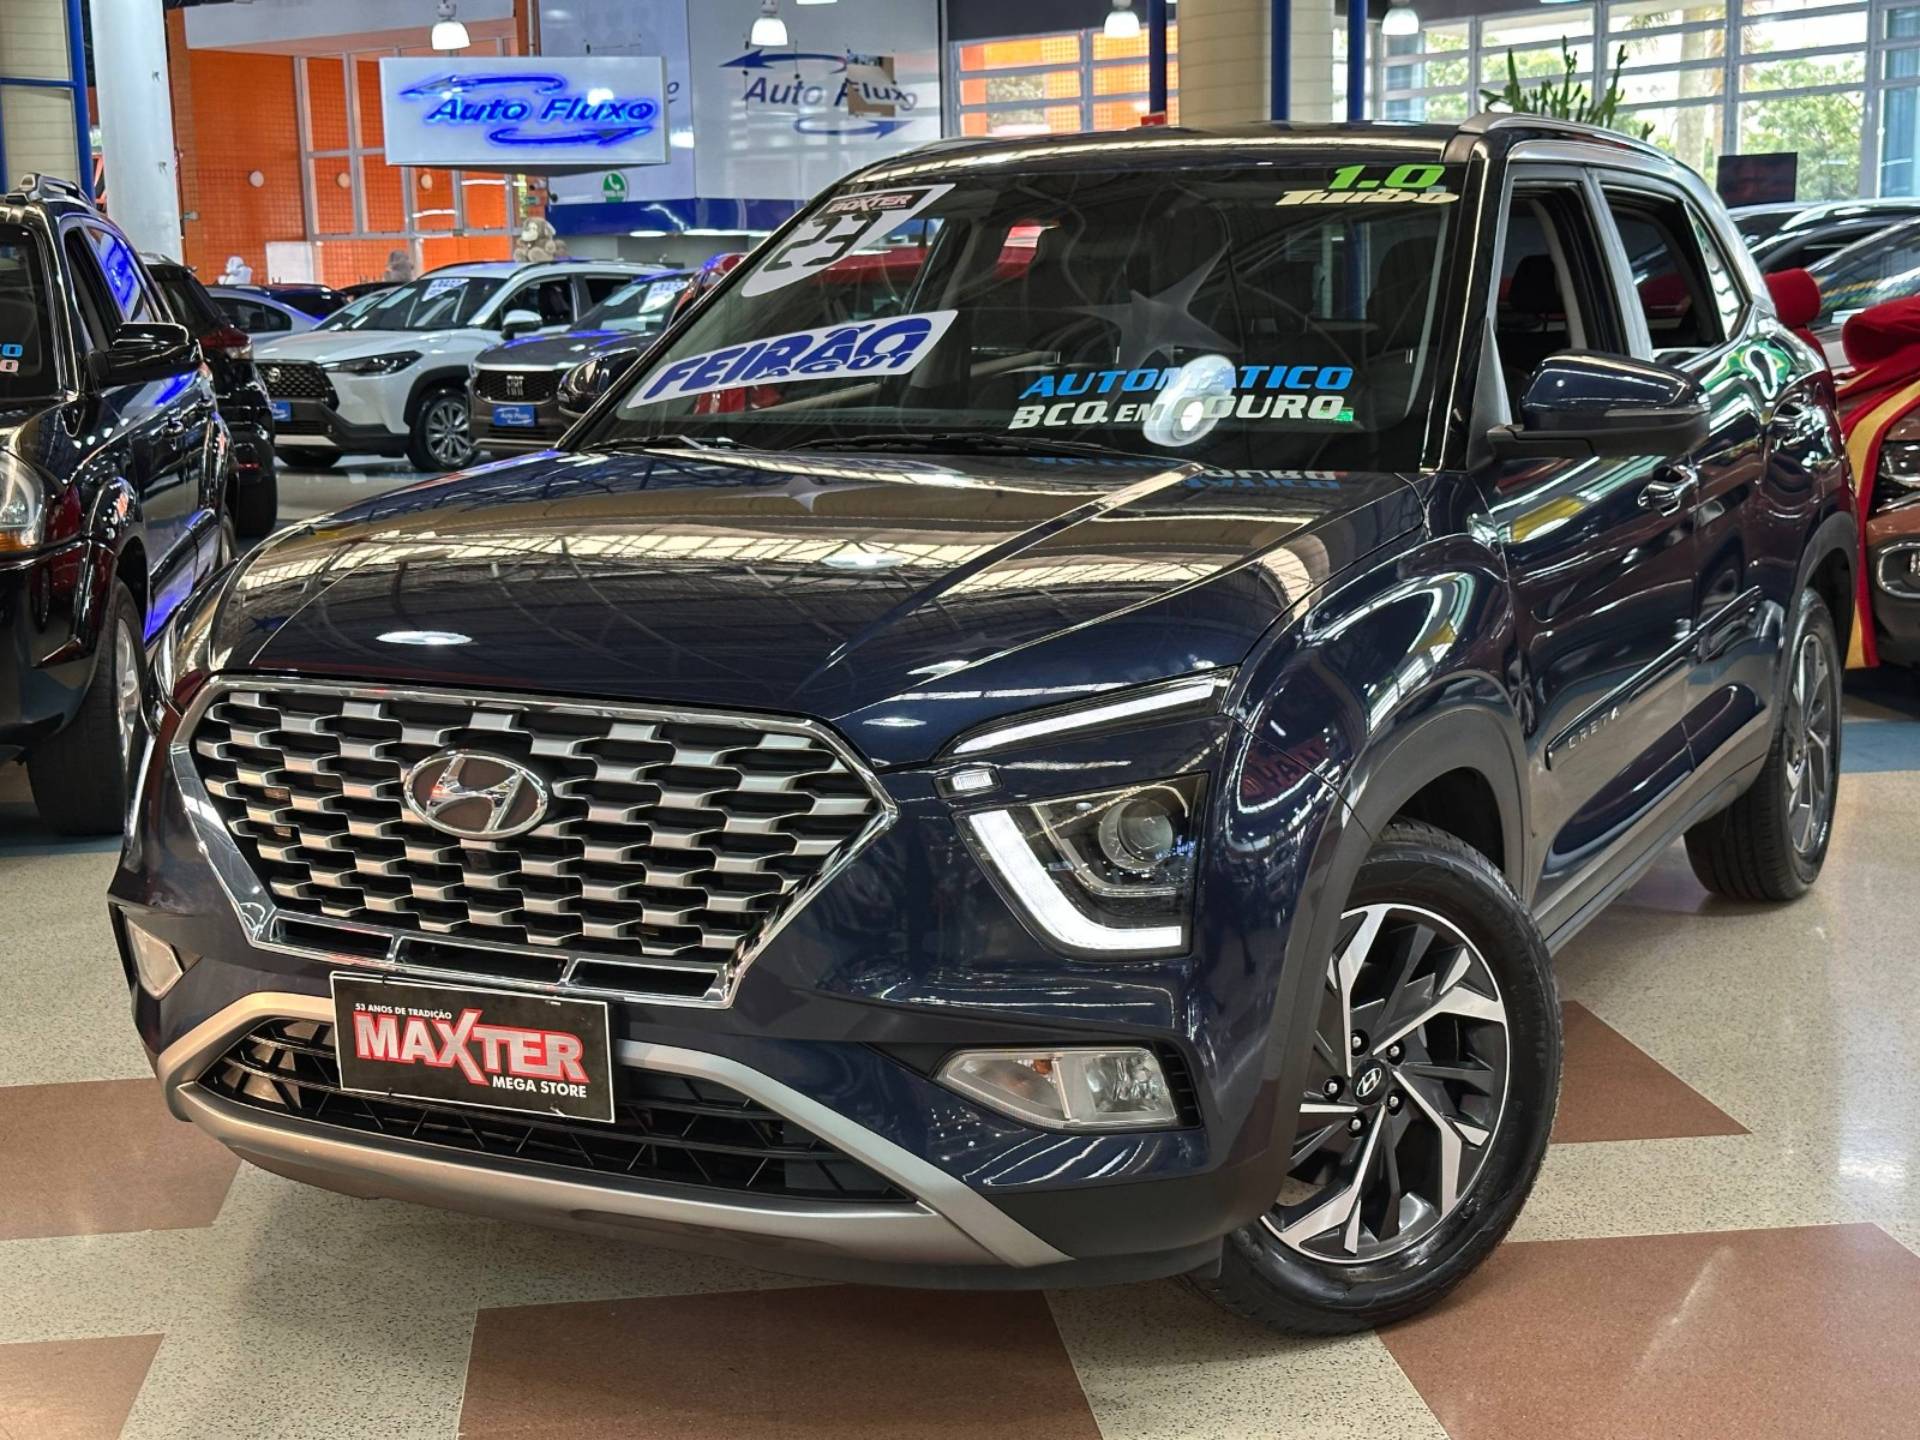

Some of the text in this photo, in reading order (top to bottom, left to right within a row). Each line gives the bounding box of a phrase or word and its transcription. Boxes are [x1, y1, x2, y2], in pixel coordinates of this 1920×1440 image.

[743, 77, 918, 111] Auto Fluxo
[427, 99, 655, 121] Auto Fluxo
[1328, 164, 1446, 190] 1.0
[1275, 188, 1460, 206] Turbo
[643, 317, 932, 400] FEIRÃO
[1018, 364, 1354, 400] AUTOMTICO
[1567, 706, 1620, 749] CRETA
[355, 1003, 453, 1021] 53 ANOS DE TRADIÇÃO
[353, 1008, 590, 1085] MAXTER
[492, 1075, 588, 1099] MEGA STORE
